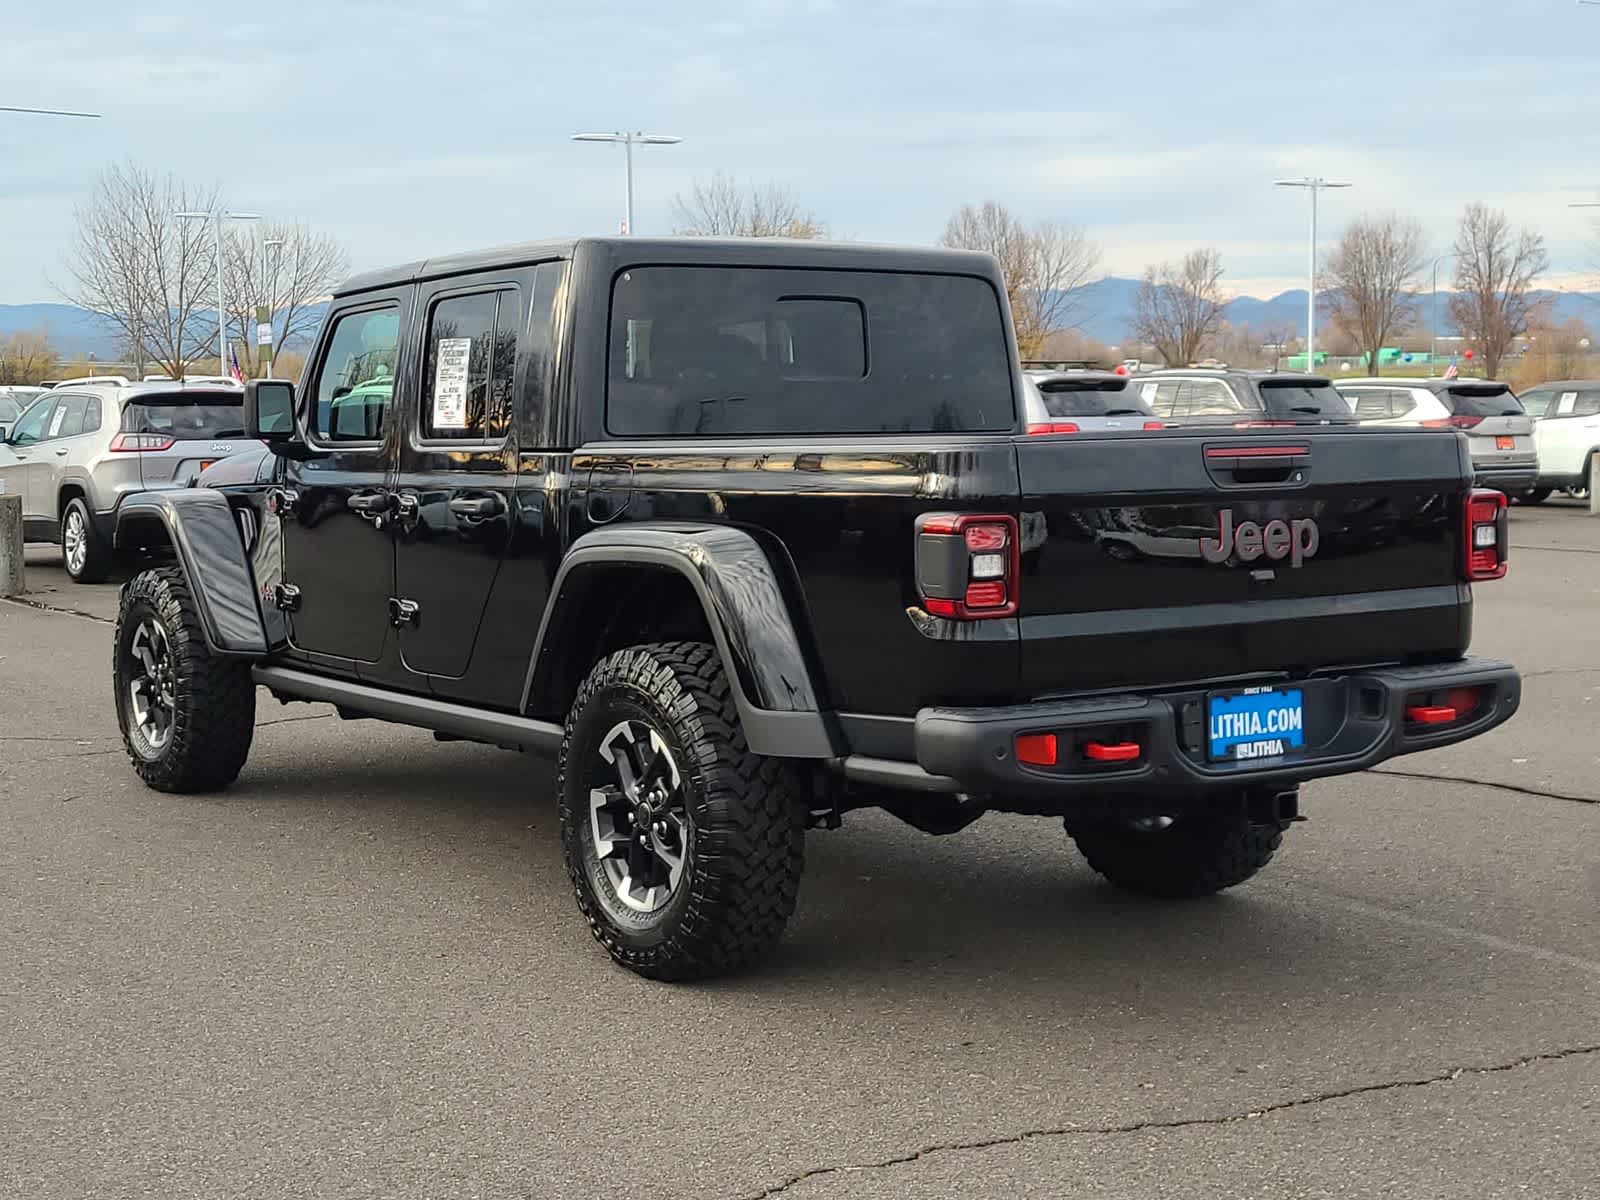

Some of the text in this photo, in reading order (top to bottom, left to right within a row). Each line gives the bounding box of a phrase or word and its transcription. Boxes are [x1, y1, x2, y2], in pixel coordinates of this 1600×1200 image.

[1199, 508, 1320, 569] Jeep
[1210, 706, 1302, 740] LITHIA.COM
[1248, 739, 1284, 757] LITHIA
